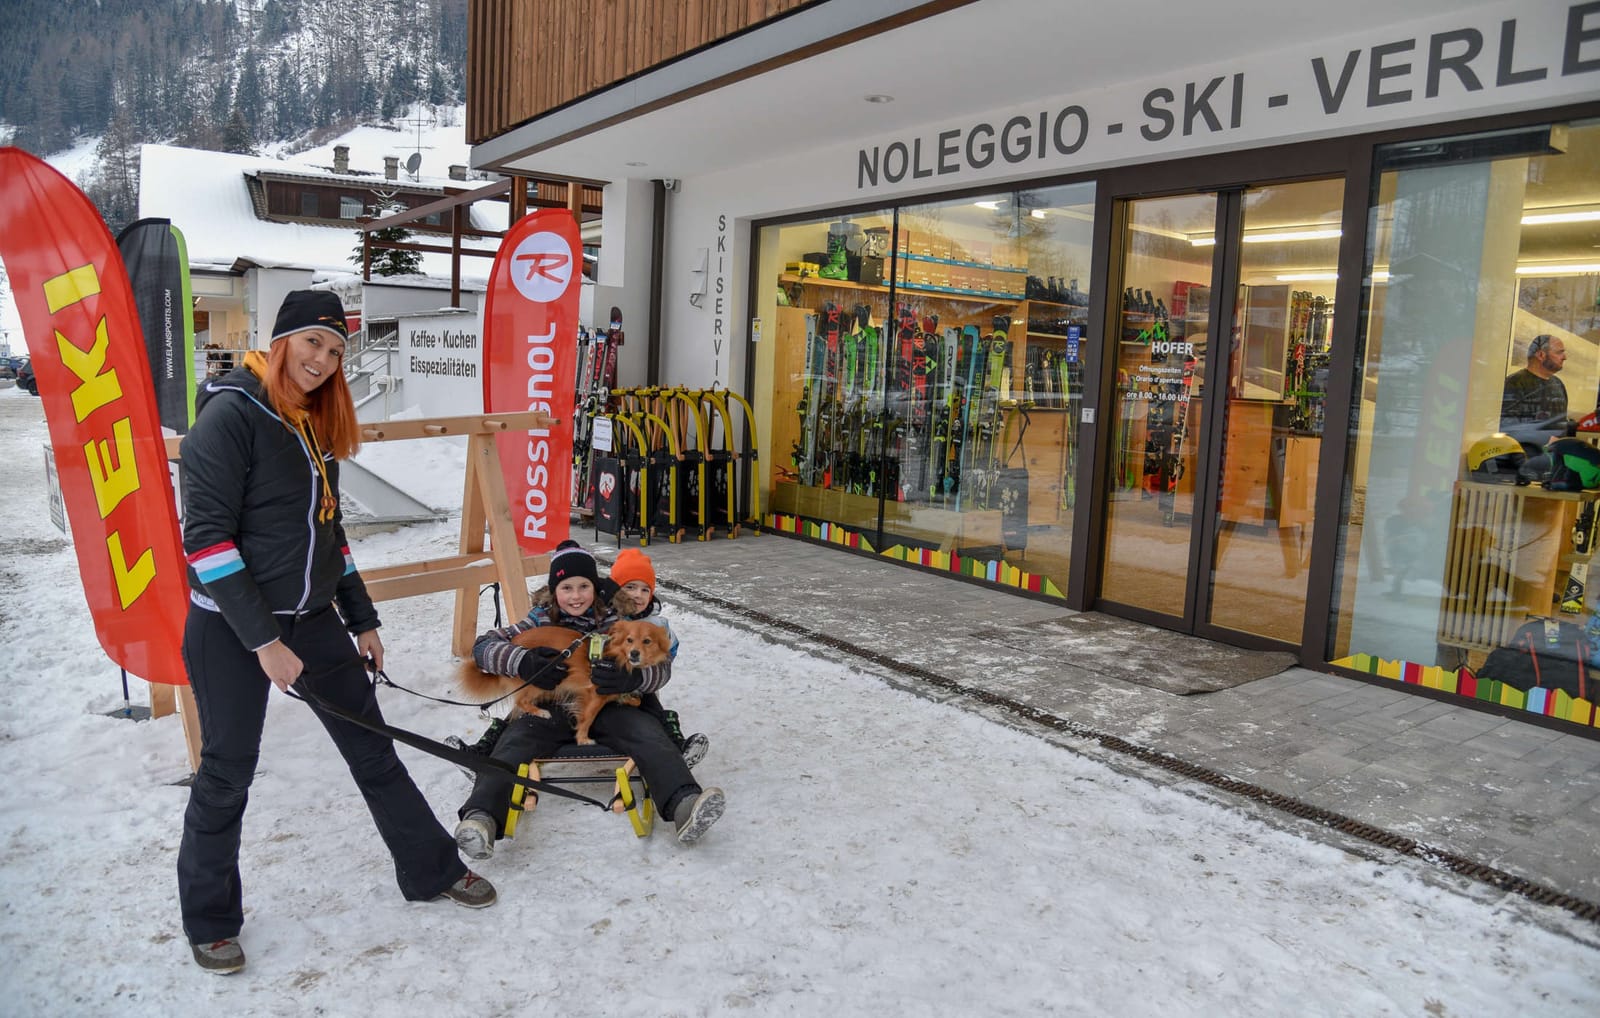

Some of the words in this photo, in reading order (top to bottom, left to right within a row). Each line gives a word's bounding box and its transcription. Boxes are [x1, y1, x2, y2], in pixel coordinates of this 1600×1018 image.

[857, 104, 1089, 189] NOLEGGIO
[1139, 72, 1245, 142] SKI
[1311, 0, 1600, 115] VERLE
[165, 288, 173, 379] WWW.ELANSPORTS.COM
[410, 330, 436, 348] Kaffee
[443, 329, 477, 349] Kuchen
[712, 214, 727, 417] SKISERVIC
[1151, 341, 1194, 355] HOFER
[410, 355, 477, 379] Eisspezialitäten
[42, 262, 157, 612] LEKI
